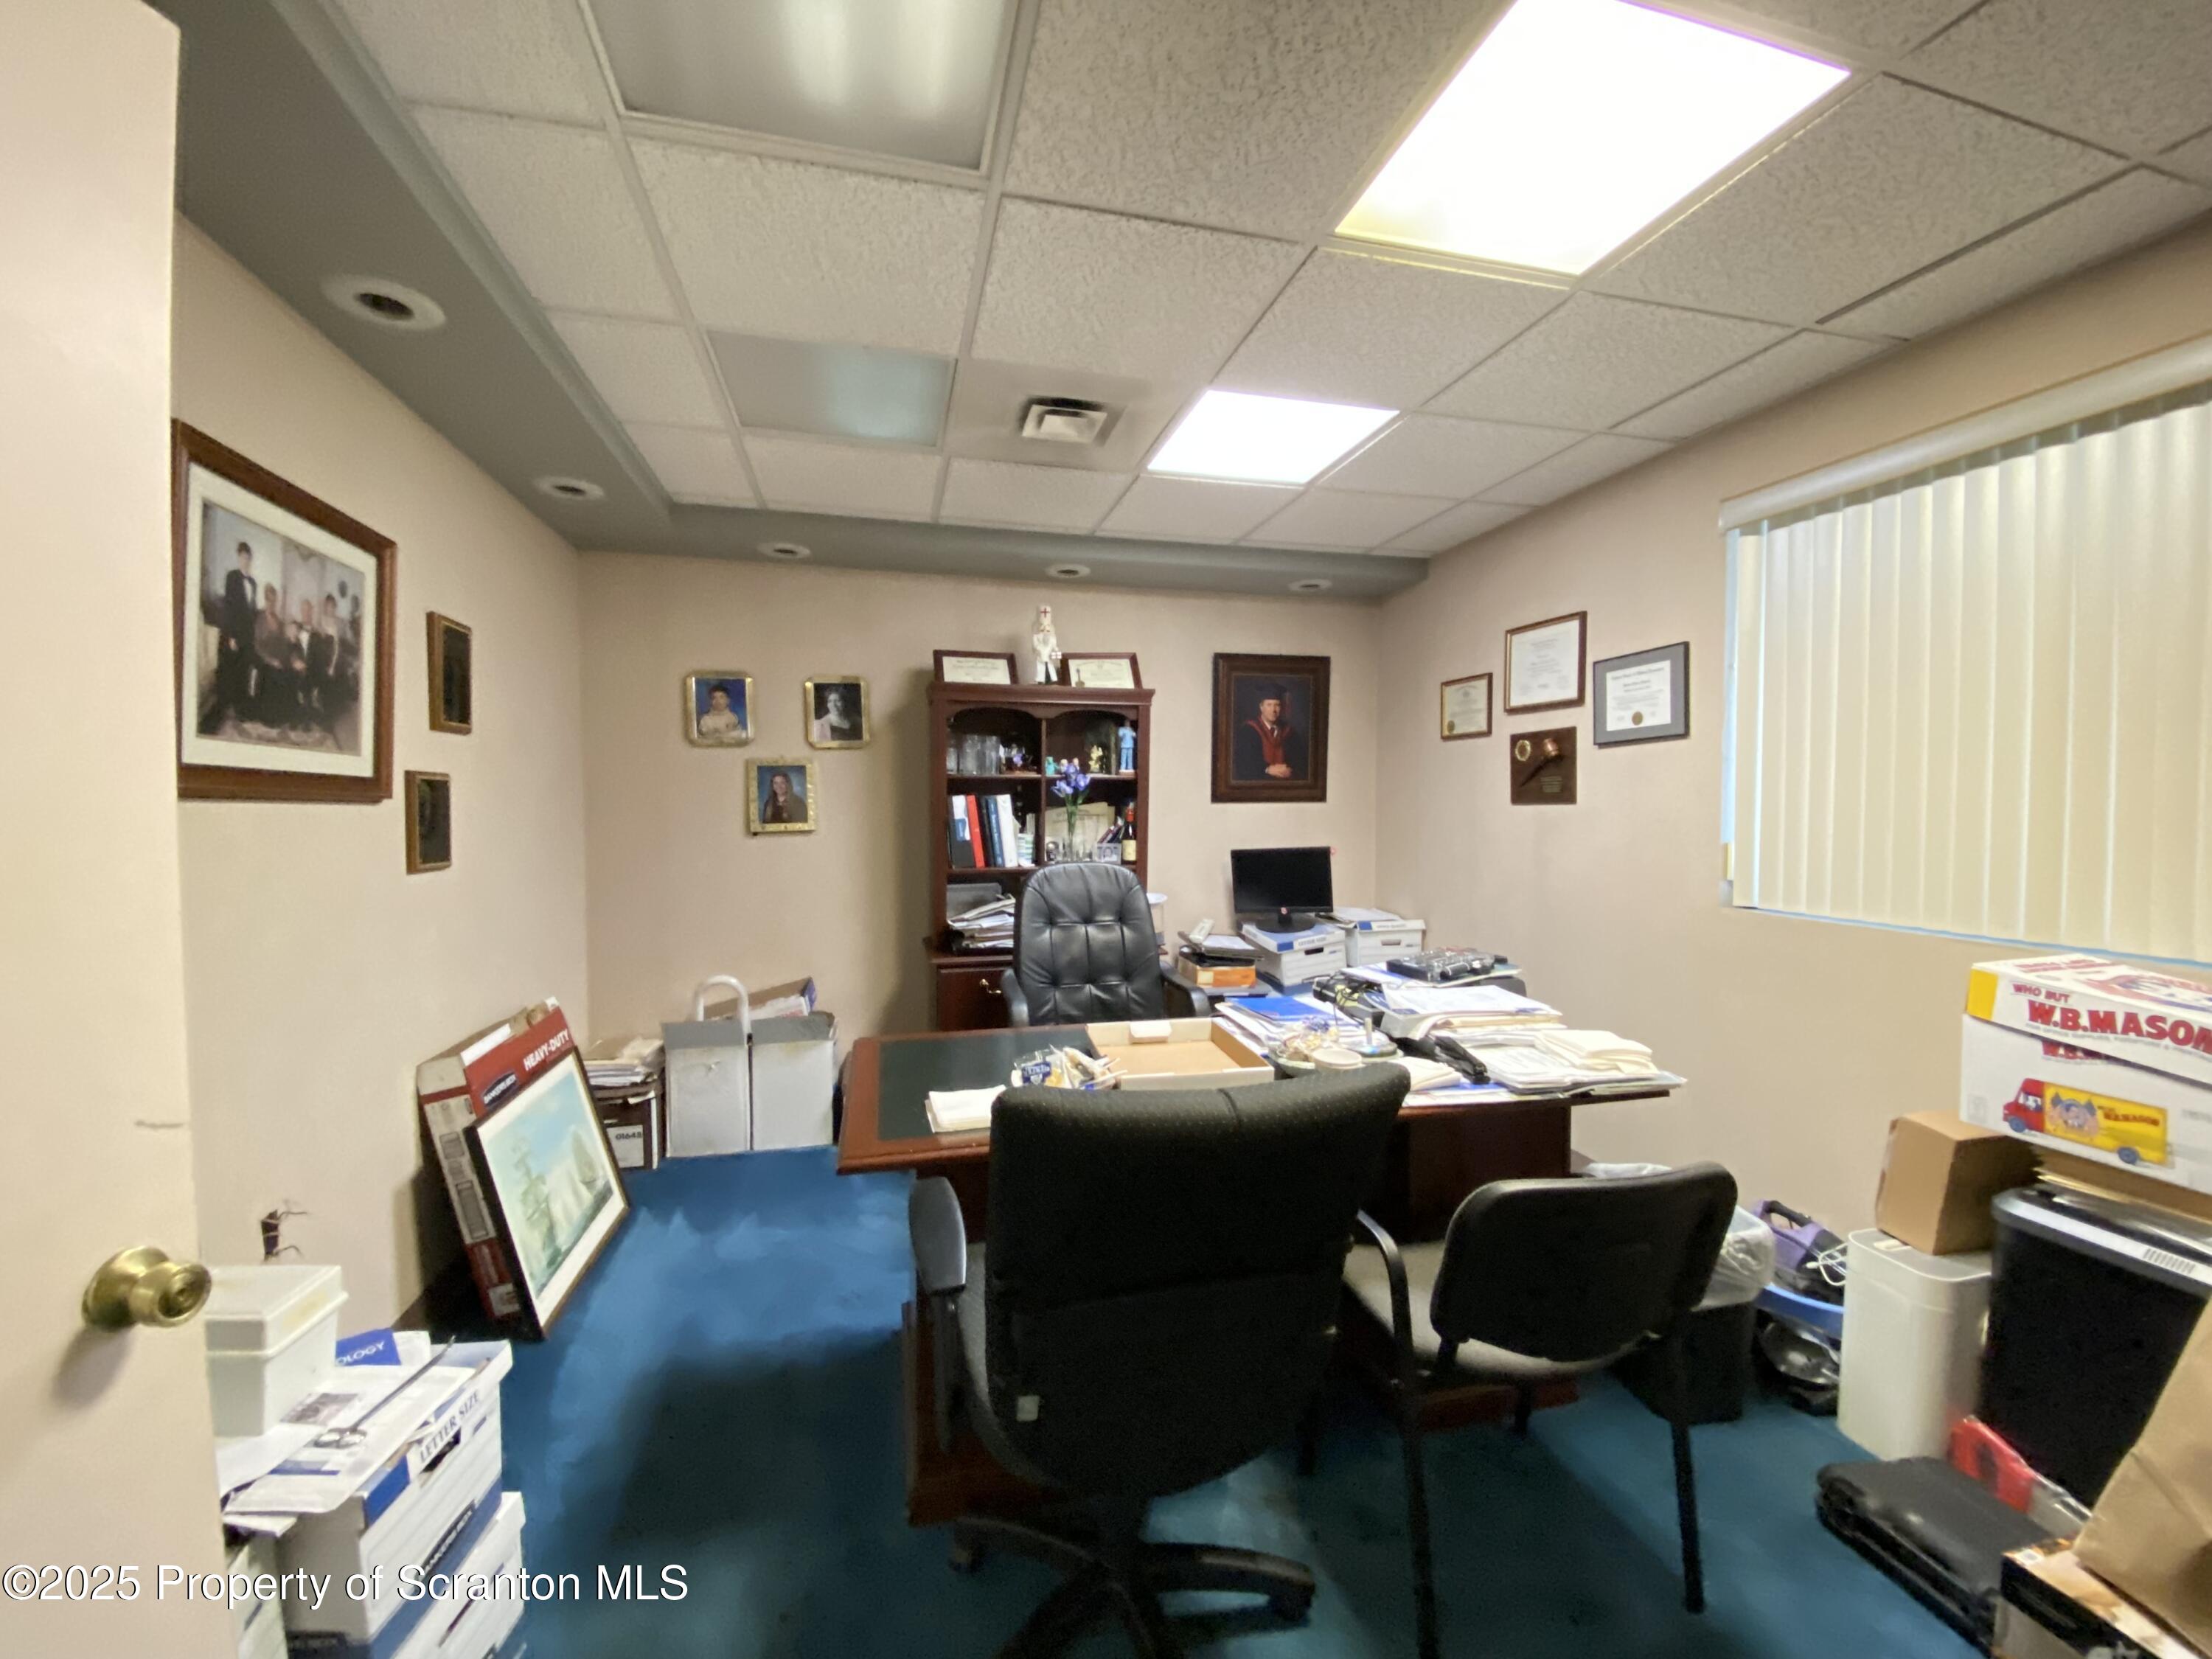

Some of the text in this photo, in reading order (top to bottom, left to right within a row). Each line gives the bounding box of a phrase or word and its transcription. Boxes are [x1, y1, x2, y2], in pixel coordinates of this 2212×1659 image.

[2013, 984, 2070, 1004] WHO BUT
[523, 1029, 569, 1071] HEAVY-DUTY
[420, 1390, 478, 1463] LETTER SIZE
